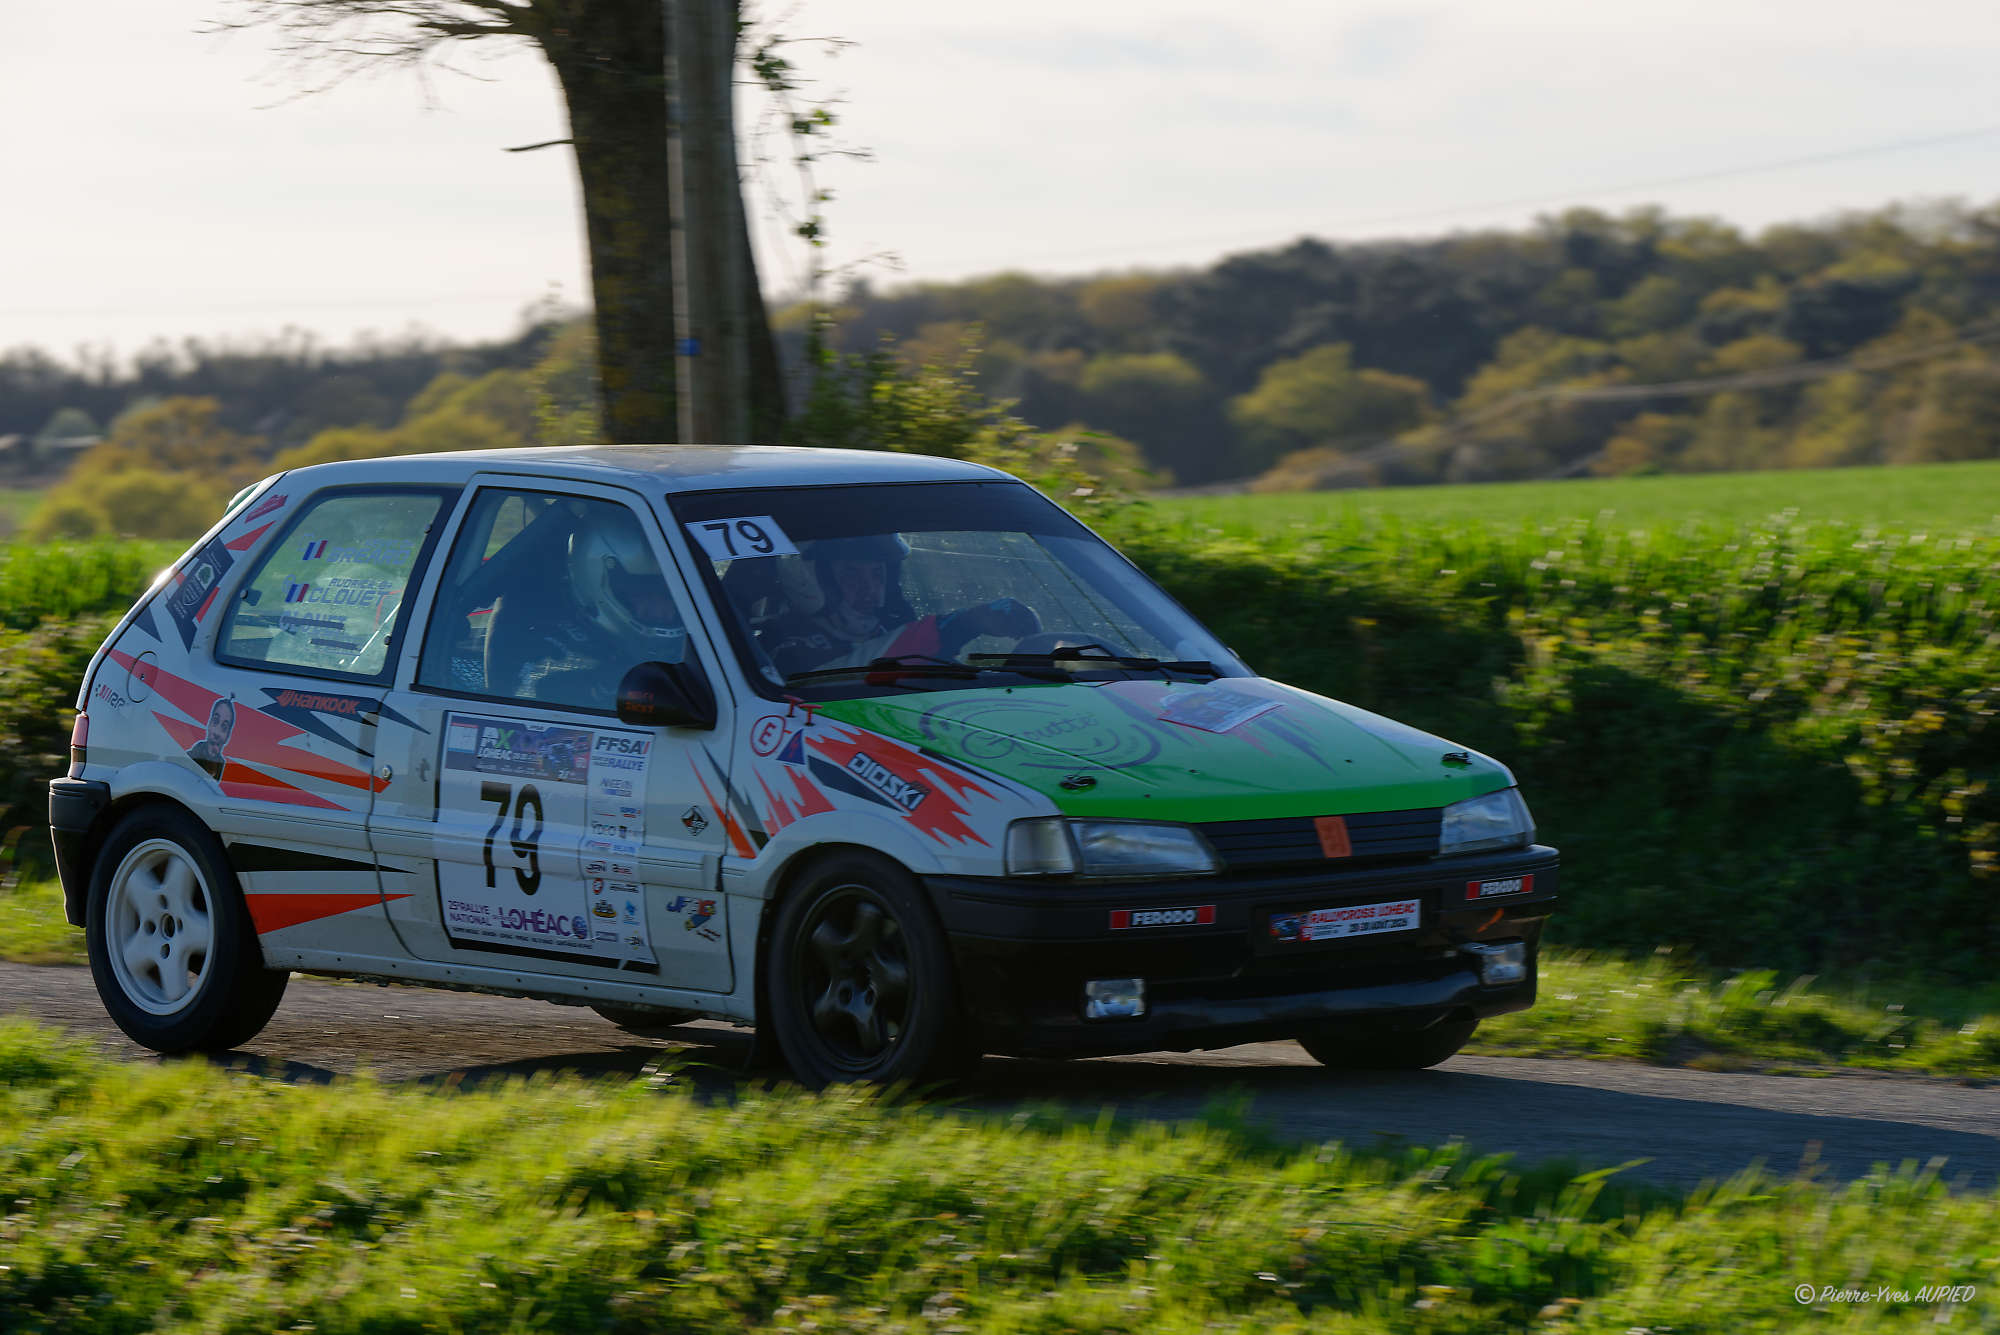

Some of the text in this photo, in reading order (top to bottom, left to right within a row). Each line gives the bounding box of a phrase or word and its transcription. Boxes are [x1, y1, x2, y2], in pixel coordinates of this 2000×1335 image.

[702, 520, 774, 556] 79
[308, 588, 389, 606] CLOUET
[757, 722, 776, 745] E
[595, 736, 643, 754] FFSA
[607, 758, 645, 771] RALLYE
[847, 752, 925, 810] DIOSKI
[480, 781, 544, 896] 79
[1480, 879, 1521, 896] FERODO
[449, 912, 492, 926] NATIONAL
[498, 906, 570, 937] LOHÉAC
[1132, 910, 1196, 926] FERODO
